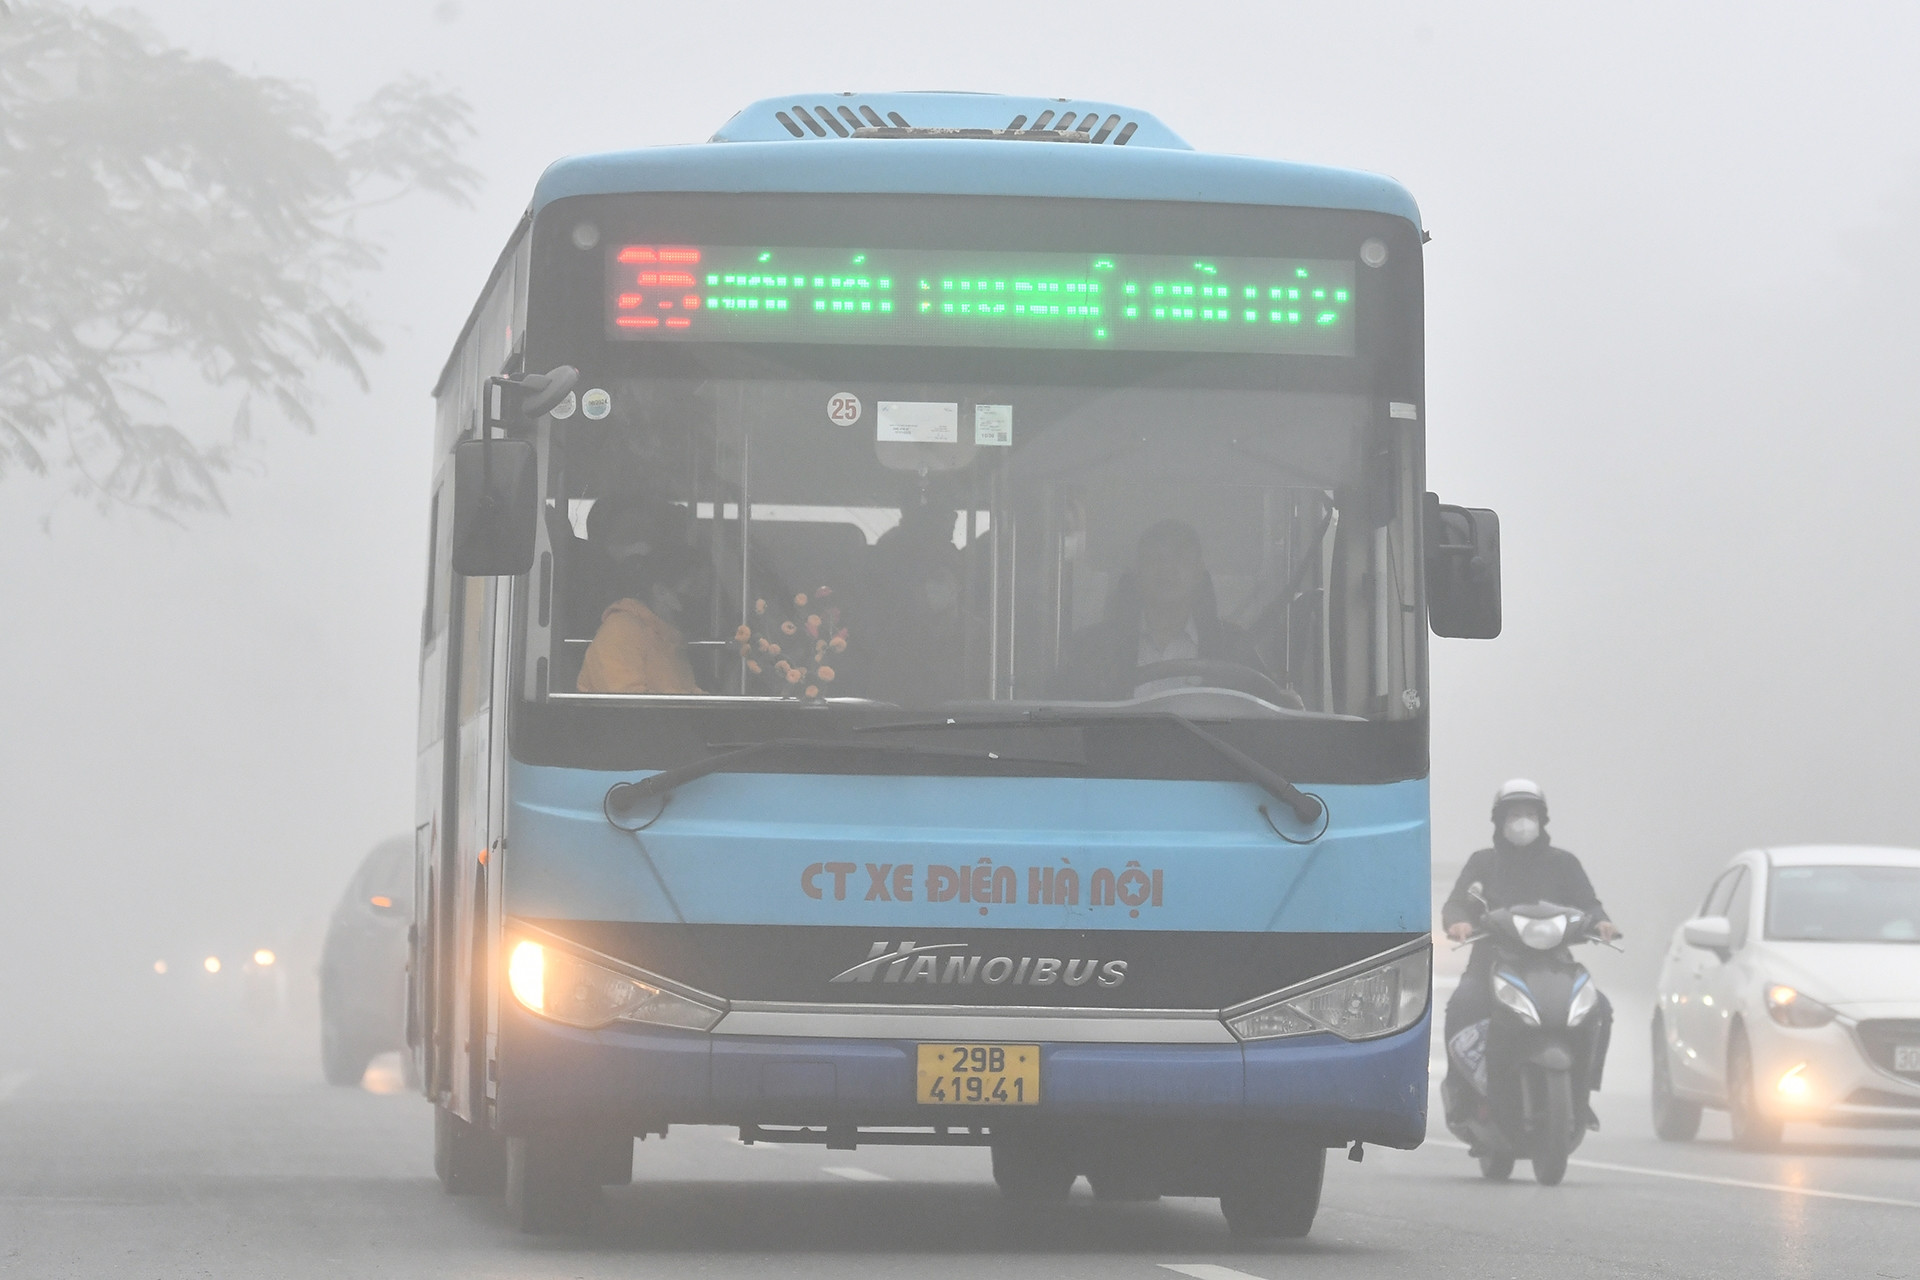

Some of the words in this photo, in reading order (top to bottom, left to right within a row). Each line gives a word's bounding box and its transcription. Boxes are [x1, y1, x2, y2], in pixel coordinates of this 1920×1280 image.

[831, 398, 857, 420] 25
[801, 862, 857, 901] CT
[864, 863, 914, 902] XE
[1027, 857, 1080, 906] HÀ
[1090, 860, 1164, 919] NỘI
[828, 940, 1128, 988] HANOIBUS
[952, 1047, 1005, 1073] 29B
[929, 1076, 1024, 1104] 419.41
